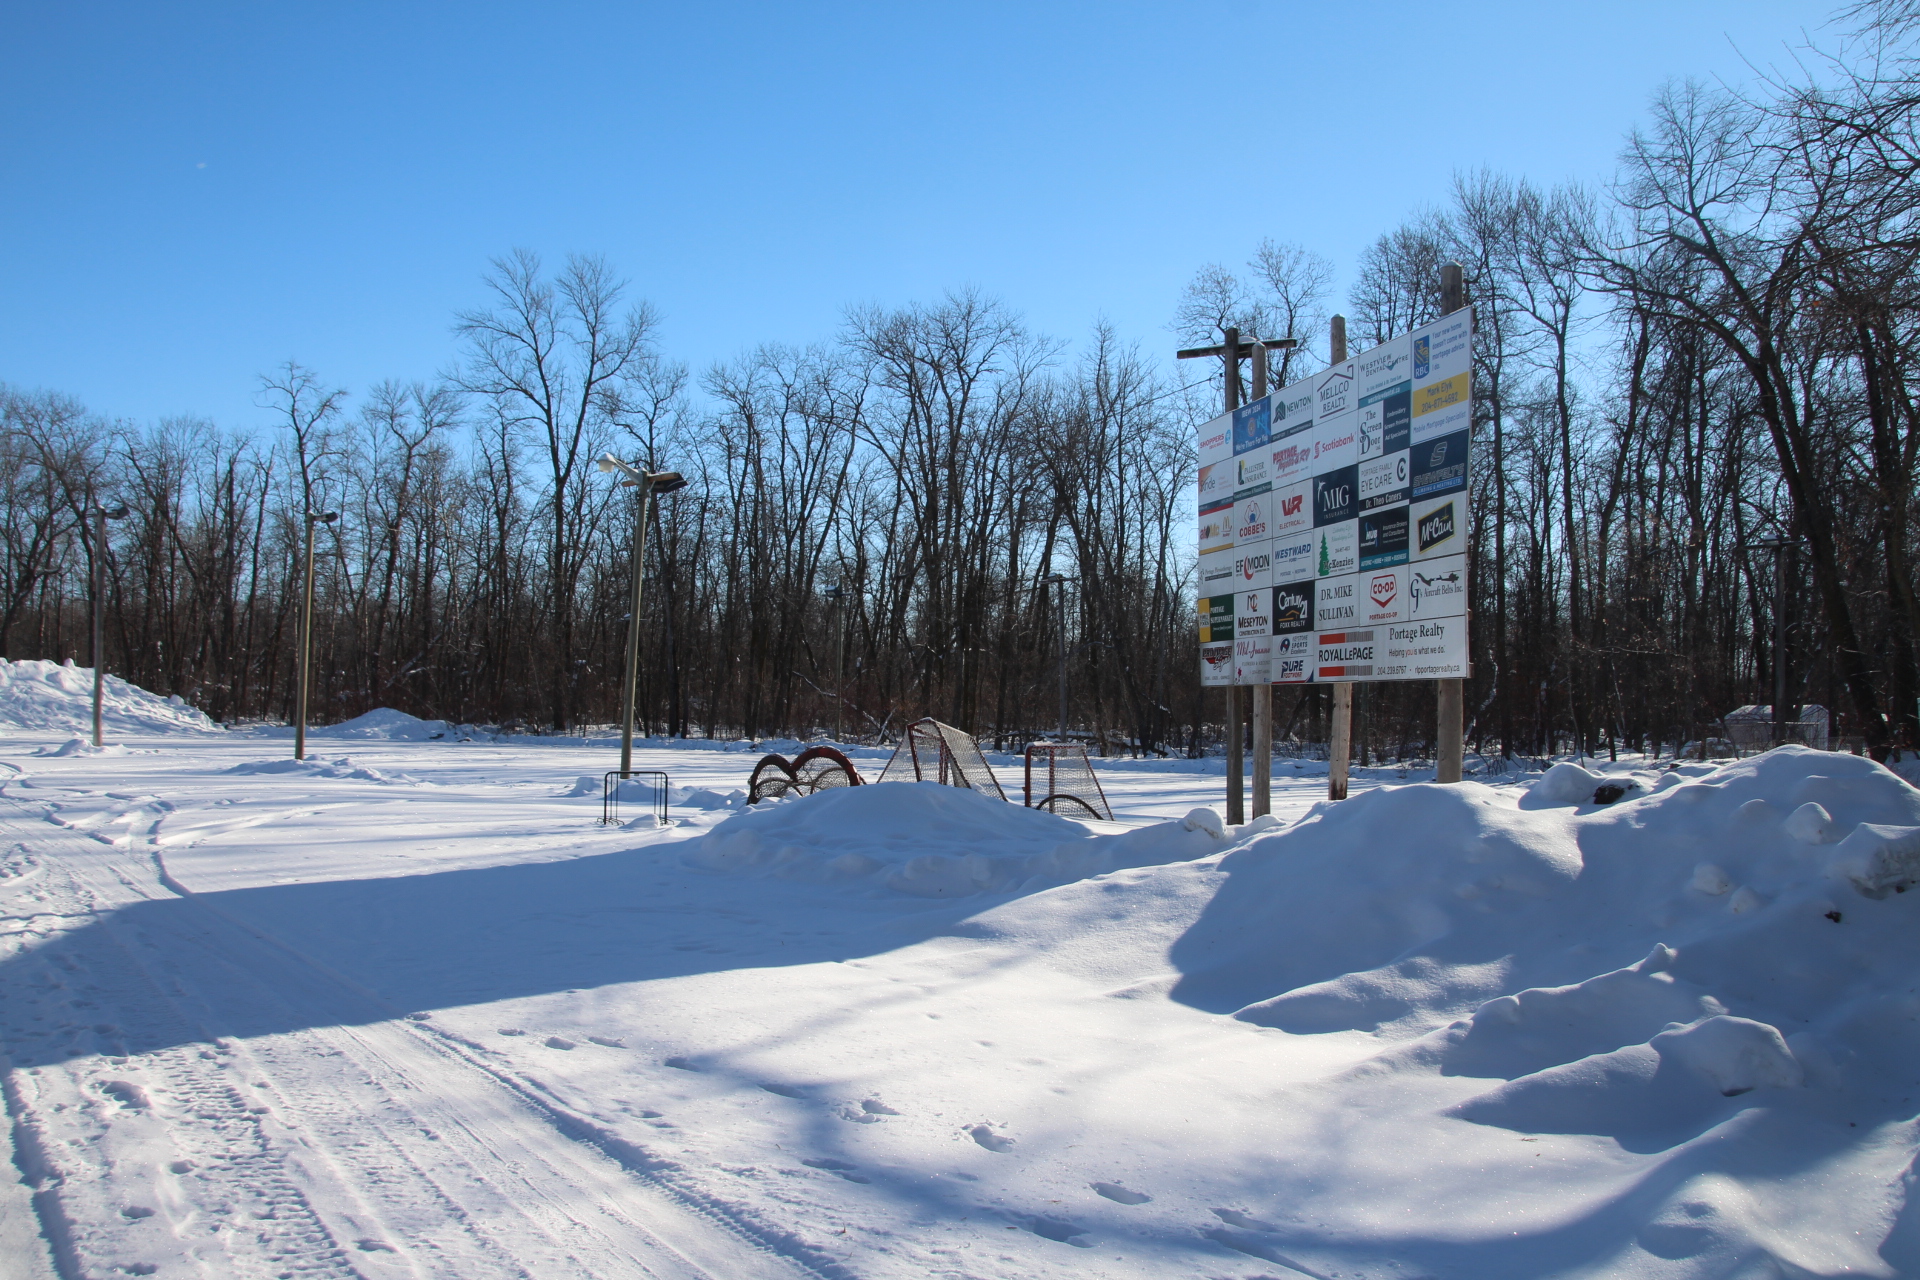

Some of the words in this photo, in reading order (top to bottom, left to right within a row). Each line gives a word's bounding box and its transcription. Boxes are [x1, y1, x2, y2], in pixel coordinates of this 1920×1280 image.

[1432, 331, 1441, 339] Your
[1451, 322, 1462, 331] home
[1447, 335, 1458, 344] come
[1458, 330, 1468, 340] with
[1360, 353, 1392, 372] WESTVIEW
[1432, 348, 1451, 361] mortgage
[1366, 364, 1386, 377] DENTAL
[1387, 354, 1409, 368] CENTRE
[1415, 364, 1429, 378] RBC
[1320, 380, 1350, 402] MELLCO
[1427, 385, 1440, 398] Mark
[1287, 395, 1312, 412] NEWTON
[1323, 395, 1346, 413] REALTY
[1365, 410, 1376, 421] The
[1413, 423, 1426, 433] Mobile
[1426, 418, 1445, 429] Mortgage
[1445, 411, 1467, 424] Specialist
[1360, 421, 1382, 436] Screen
[1200, 433, 1225, 449] SHOPPERS
[1322, 433, 1354, 452] Scotiabank
[1360, 434, 1381, 455] Door
[1273, 445, 1297, 464] PORTAGE
[1361, 466, 1378, 477] PORTAGE
[1379, 462, 1392, 471] FAMILY
[1413, 463, 1465, 488] SHEWFELT'S
[1361, 478, 1373, 493] EYE
[1374, 472, 1392, 489] CARE
[1323, 485, 1349, 511] MIG
[1373, 496, 1385, 507] Theo
[1385, 492, 1402, 504] Caners
[1324, 508, 1349, 519] INSURANCE
[1240, 522, 1266, 538] COBBE'S
[1279, 520, 1301, 530] ELECTRICAL
[1420, 517, 1454, 546] McCain
[1275, 543, 1311, 560] WESTWARD
[1236, 559, 1244, 573] EF
[1248, 553, 1270, 571] MOON
[1322, 557, 1354, 570] McKenzies
[1321, 588, 1333, 601] DR.
[1334, 584, 1352, 599] MIKE
[1423, 586, 1441, 597] Aircraft
[1441, 584, 1453, 595] Belts
[1454, 583, 1464, 593] Inc.
[1279, 591, 1303, 610] Century
[1300, 600, 1308, 619] 21
[1318, 604, 1354, 621] SULLIVAN
[1238, 615, 1268, 629] MESEYTON
[1291, 620, 1305, 628] REALTY
[1389, 627, 1418, 643] Portage
[1419, 622, 1445, 640] Realty
[1292, 641, 1308, 650] SPORTS
[1389, 648, 1405, 658] Helping
[1405, 649, 1414, 657] you
[1418, 645, 1429, 655] what
[1281, 660, 1304, 678] PURE
